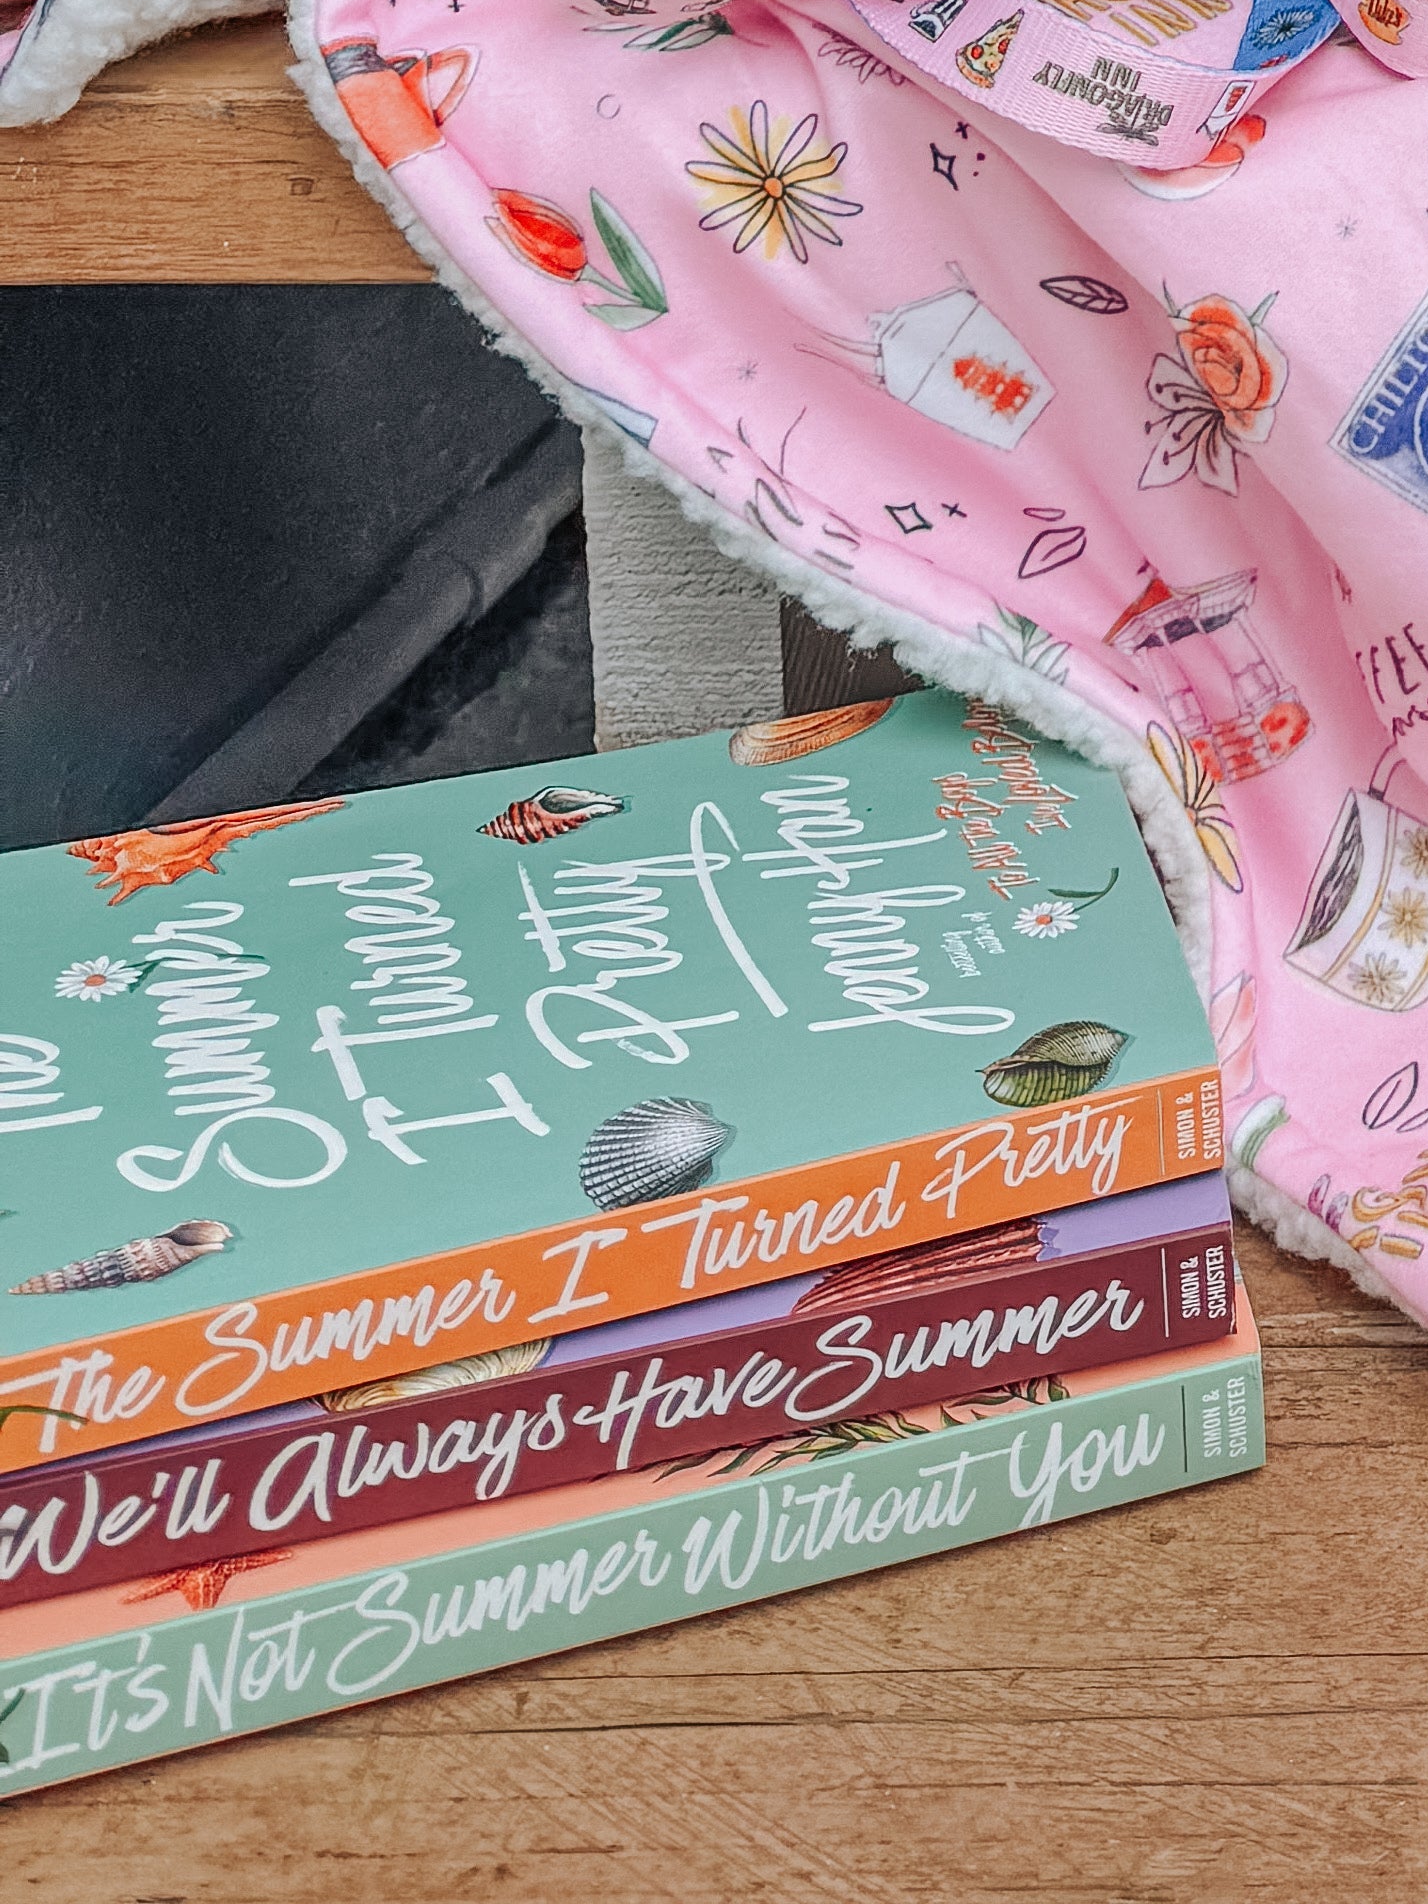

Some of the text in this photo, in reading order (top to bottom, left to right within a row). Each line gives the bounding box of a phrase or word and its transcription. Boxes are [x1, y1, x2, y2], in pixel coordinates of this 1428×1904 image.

[742, 774, 948, 891] Han
[288, 851, 551, 1166] I Turned
[518, 851, 740, 1070] Pretty
[806, 884, 1017, 1036] Jenny
[115, 900, 349, 1193] Summer
[1176, 1109, 1197, 1160] SIMON
[1202, 1077, 1222, 1160] SCHUSTER
[0, 1095, 1146, 1454] The Summer I Turned Pretty
[1181, 1273, 1201, 1320] SIMON
[1206, 1244, 1226, 1318] SCHUSTER
[0, 1279, 1147, 1581] We'll Always Have Summer
[1202, 1406, 1224, 1461] SIMON
[1227, 1376, 1247, 1459] SCHUSTER
[0, 1411, 1169, 1778] It's Not Summer Without You
